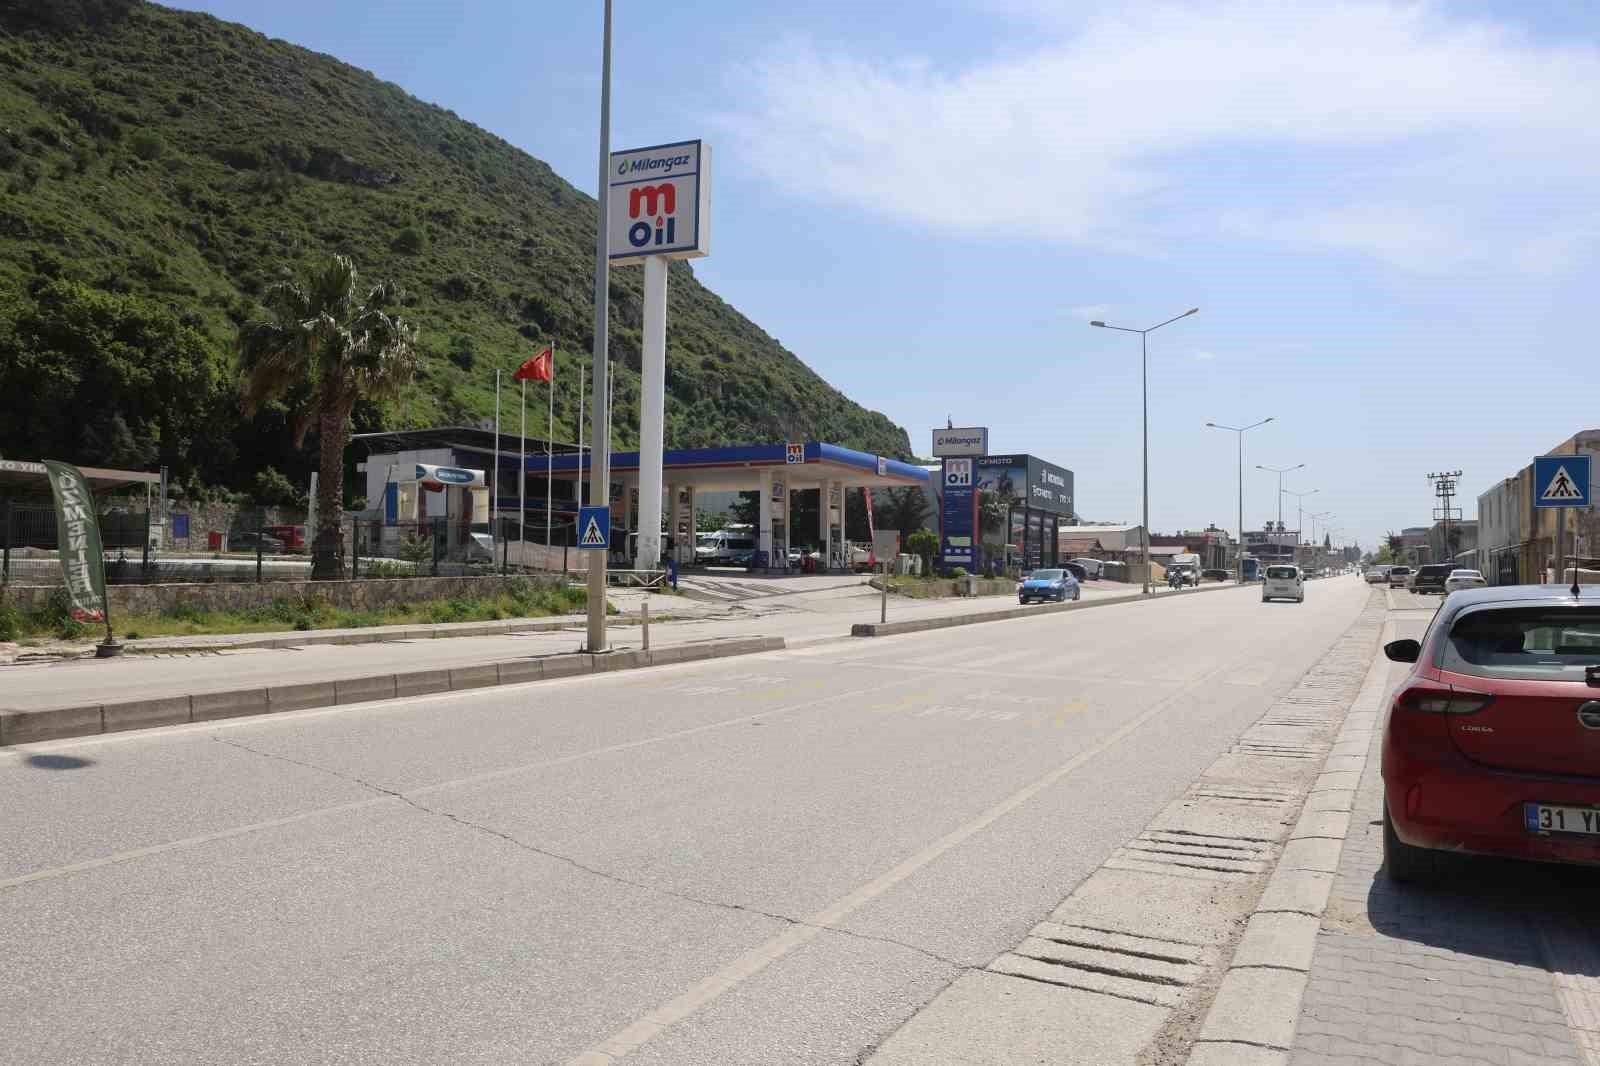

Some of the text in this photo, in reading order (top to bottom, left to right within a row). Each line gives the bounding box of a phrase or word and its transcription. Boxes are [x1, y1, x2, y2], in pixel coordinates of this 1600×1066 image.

[630, 155, 690, 172] Milangaz
[629, 182, 676, 219] m
[629, 215, 675, 247] oil
[945, 436, 981, 447] Milangaz
[947, 472, 969, 484] oil
[1540, 808, 1565, 830] 31
